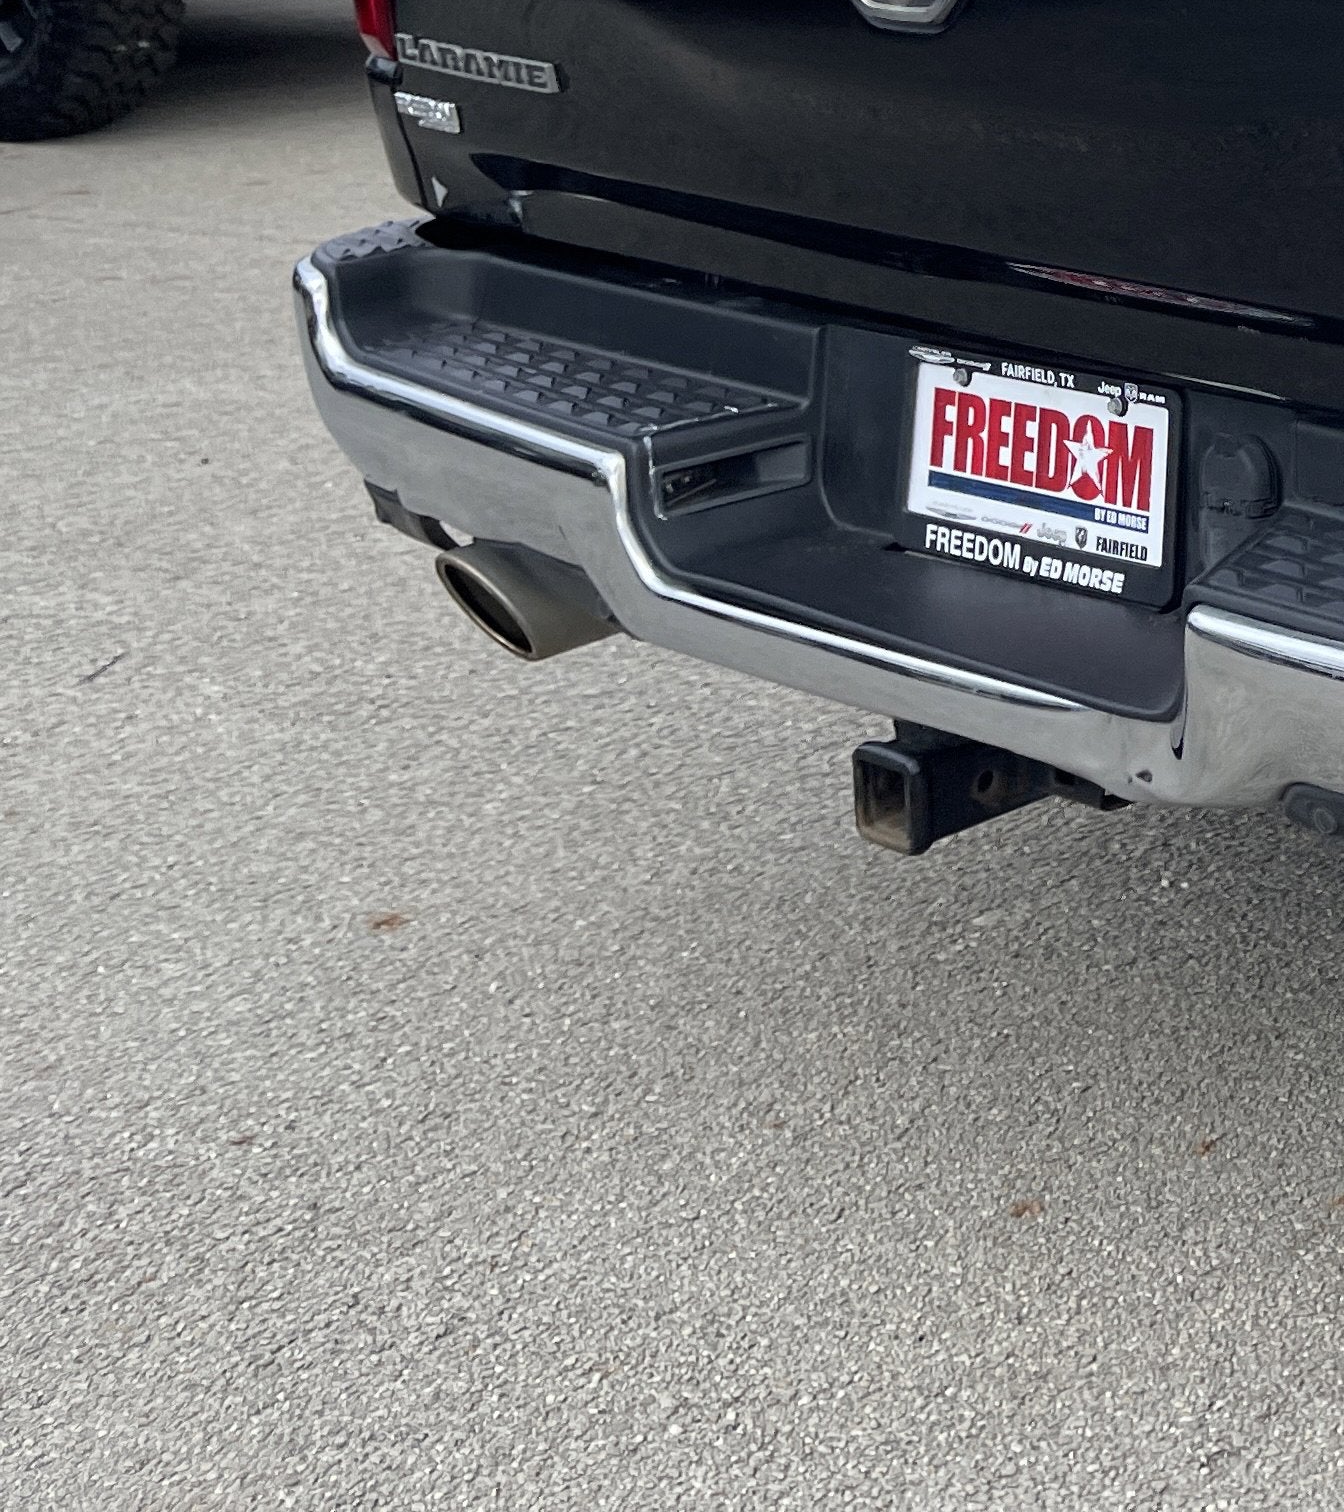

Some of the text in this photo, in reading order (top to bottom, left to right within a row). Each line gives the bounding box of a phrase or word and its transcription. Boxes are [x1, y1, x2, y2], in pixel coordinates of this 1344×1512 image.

[395, 33, 560, 93] LARAMIE
[1001, 362, 1057, 387] FAIRFIELD,
[1059, 373, 1075, 388] TX
[931, 387, 1154, 512] FREEDOM
[1117, 513, 1147, 531] MORSE
[925, 524, 1021, 570] FREEDOM
[1039, 556, 1063, 580] ED
[1063, 561, 1125, 594] MORSE
[1096, 536, 1148, 561] FAIRFIELD
